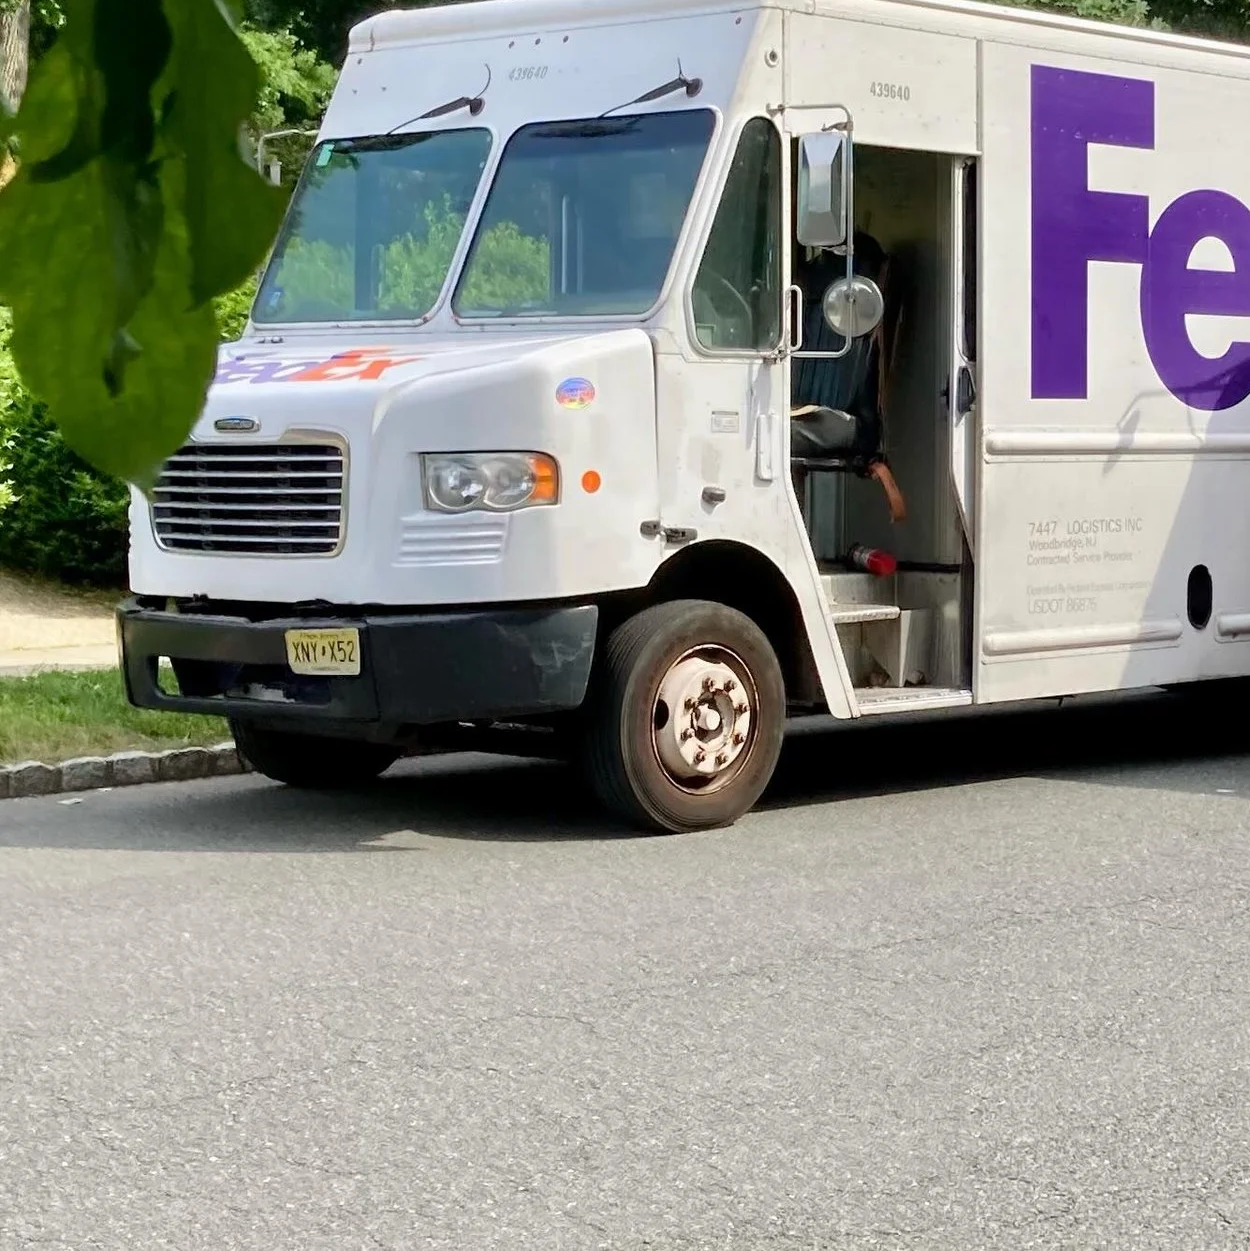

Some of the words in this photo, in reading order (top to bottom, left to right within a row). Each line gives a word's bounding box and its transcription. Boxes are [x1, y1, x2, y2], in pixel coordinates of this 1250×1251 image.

[870, 81, 910, 101] 439640
[214, 346, 425, 385] edEx
[1028, 520, 1057, 536] 7447
[1067, 518, 1122, 535] LOGISTICS
[1124, 517, 1143, 532] INC
